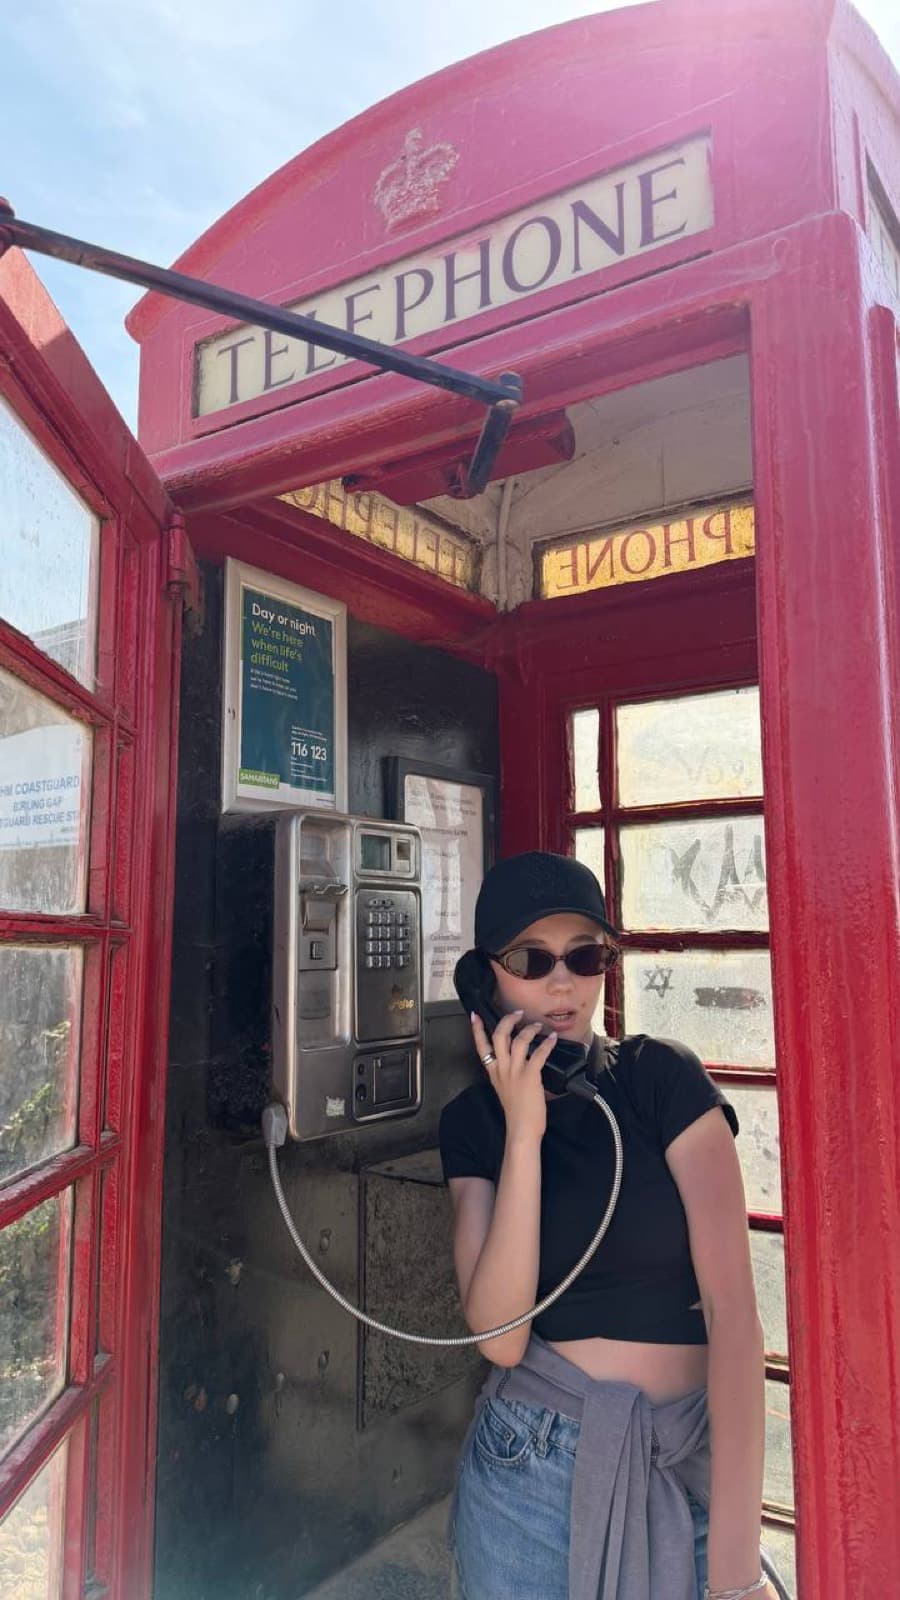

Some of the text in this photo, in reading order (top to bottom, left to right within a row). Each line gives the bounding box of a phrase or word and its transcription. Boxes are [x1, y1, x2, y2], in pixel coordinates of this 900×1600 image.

[217, 157, 687, 403] TELEPHONE
[251, 602, 316, 636] Day or night
[251, 621, 304, 646] We're here
[251, 638, 303, 661] when life's
[250, 650, 289, 672] difficult
[290, 741, 327, 761] 116 123
[15, 775, 80, 795] COASTGUARD
[33, 811, 65, 825] RESCUE
